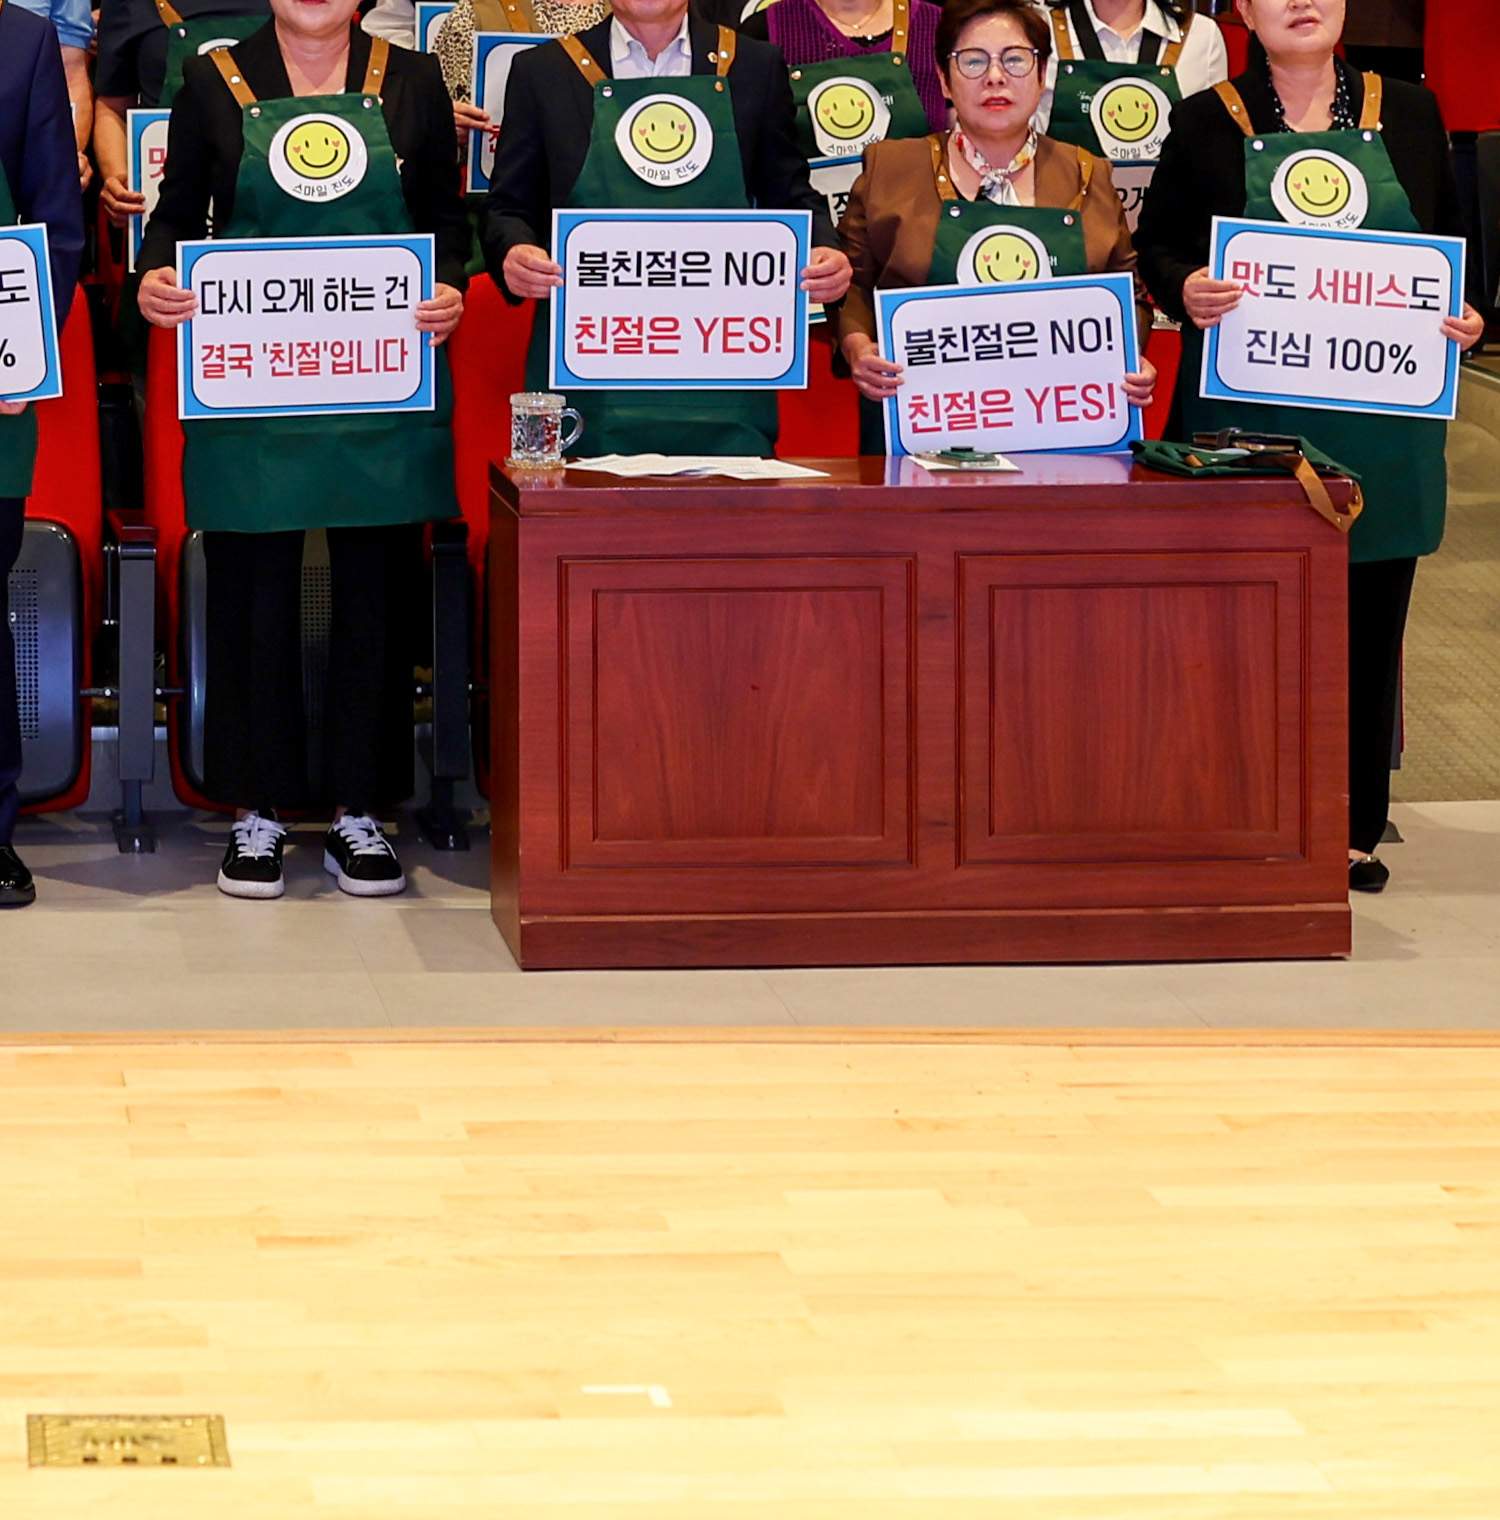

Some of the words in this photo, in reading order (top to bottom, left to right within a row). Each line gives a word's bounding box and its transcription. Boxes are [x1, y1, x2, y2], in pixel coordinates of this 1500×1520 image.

[1110, 147, 1143, 160] 스마일
[1144, 136, 1165, 153] 진도
[292, 184, 327, 196] 스마일
[333, 177, 354, 192] 진도
[638, 164, 671, 181] 스마일
[676, 162, 698, 178] 진도
[577, 251, 711, 287] 불친절은
[725, 252, 785, 286] NO!
[1232, 261, 1296, 299] 맛도
[1308, 269, 1440, 311] 서비스도
[201, 280, 251, 314] 다시
[262, 279, 313, 313] 오게
[324, 278, 375, 311] 하는
[386, 276, 408, 309] 건
[575, 317, 681, 354] 친절은
[694, 317, 782, 353] YES!
[904, 322, 1038, 366] 불친절은
[1050, 317, 1113, 354] NO!
[1247, 329, 1311, 368] 진심
[1327, 338, 1416, 374] 100%
[202, 344, 253, 379] 결국
[263, 338, 408, 376] '친절'입니다
[909, 390, 1013, 433] 친절은
[1025, 383, 1116, 423] YES!
